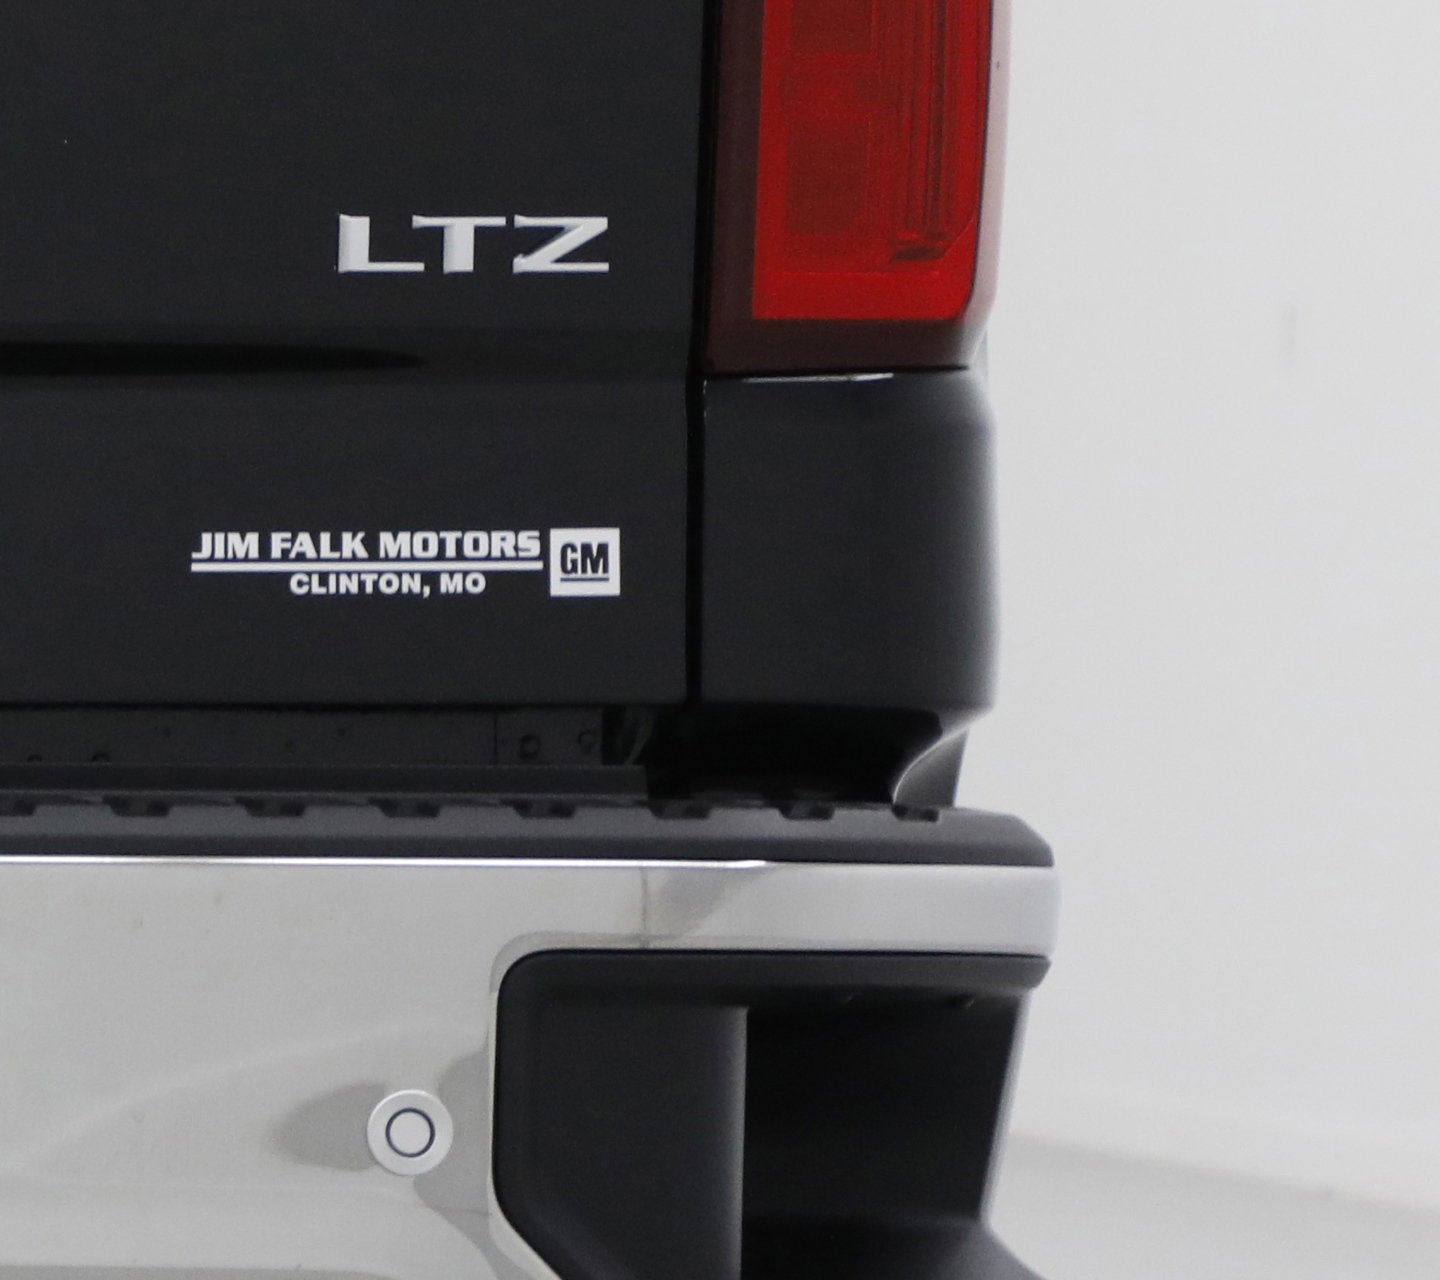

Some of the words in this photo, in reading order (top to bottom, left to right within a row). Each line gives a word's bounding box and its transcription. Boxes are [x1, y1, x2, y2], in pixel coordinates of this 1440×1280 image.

[339, 214, 609, 273] LTZ
[192, 532, 259, 559] JIM
[271, 532, 368, 558] FALK
[380, 531, 540, 558] MOTORS
[560, 543, 610, 575] GM
[289, 572, 431, 598] CLINTON,
[439, 572, 486, 594] MO
